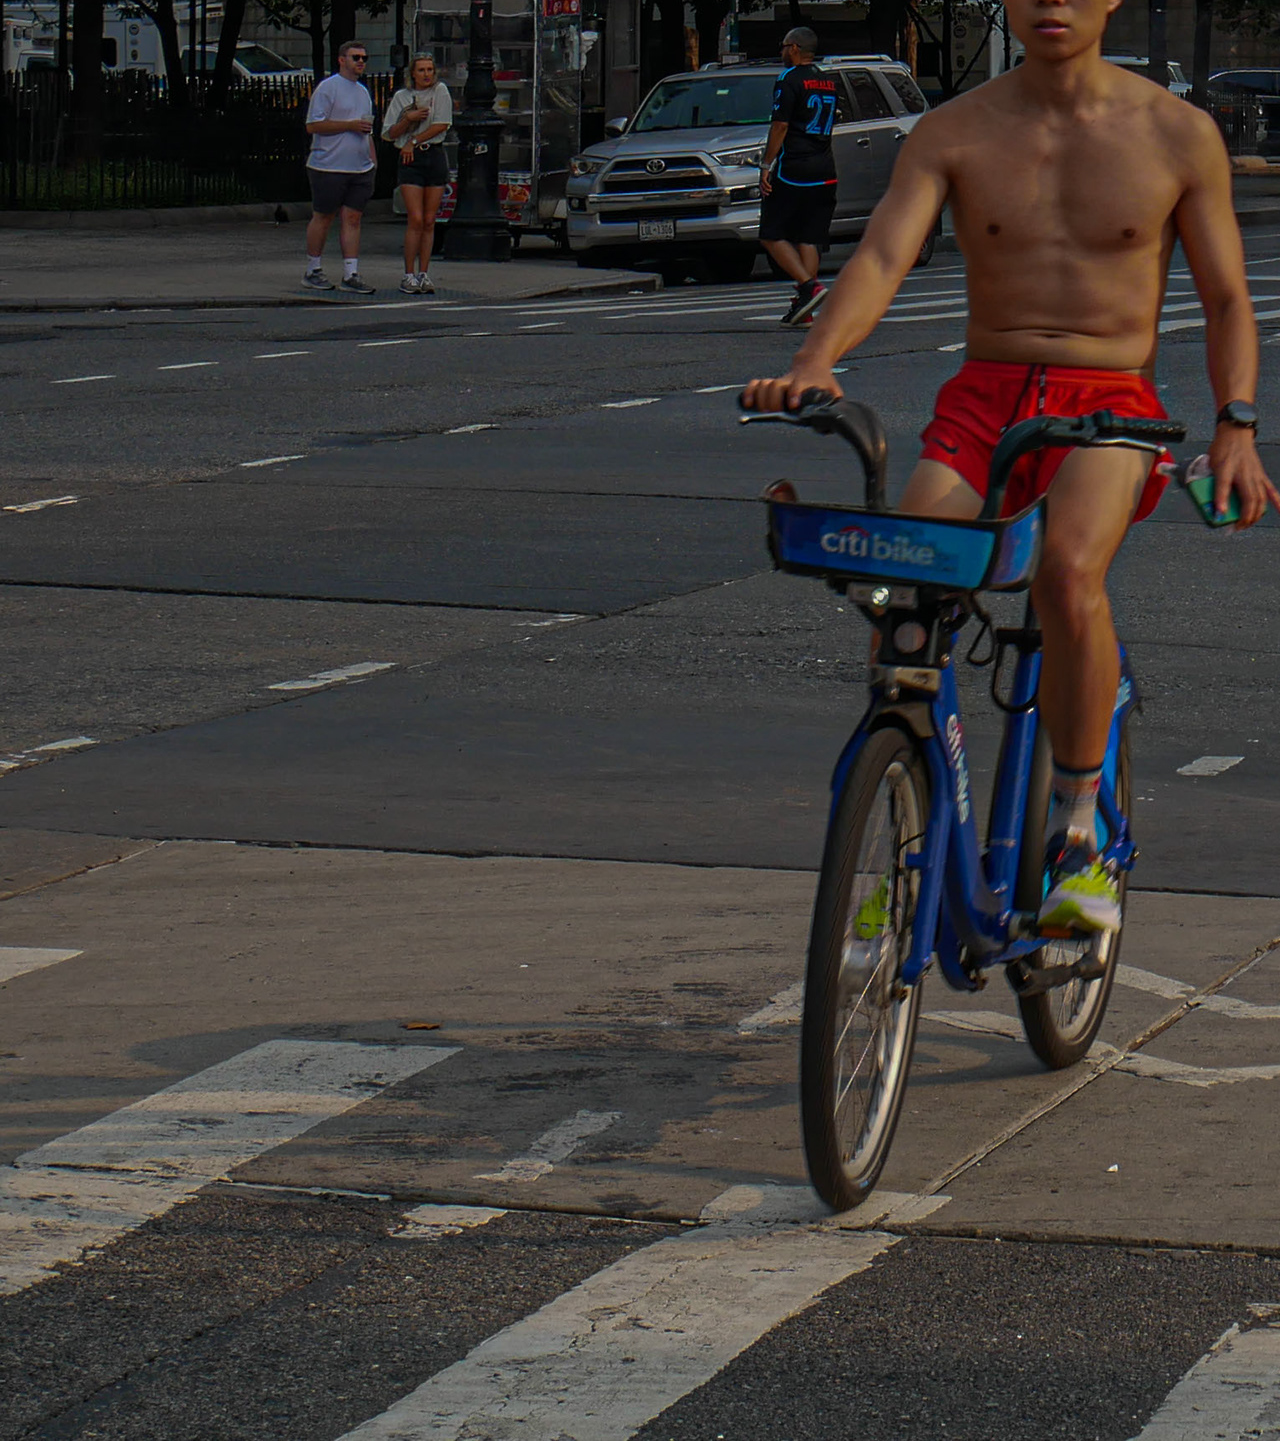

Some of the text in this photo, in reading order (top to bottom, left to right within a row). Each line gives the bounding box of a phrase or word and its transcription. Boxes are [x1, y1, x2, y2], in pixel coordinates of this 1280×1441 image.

[806, 93, 836, 136] 27
[820, 529, 936, 566] citi bike
